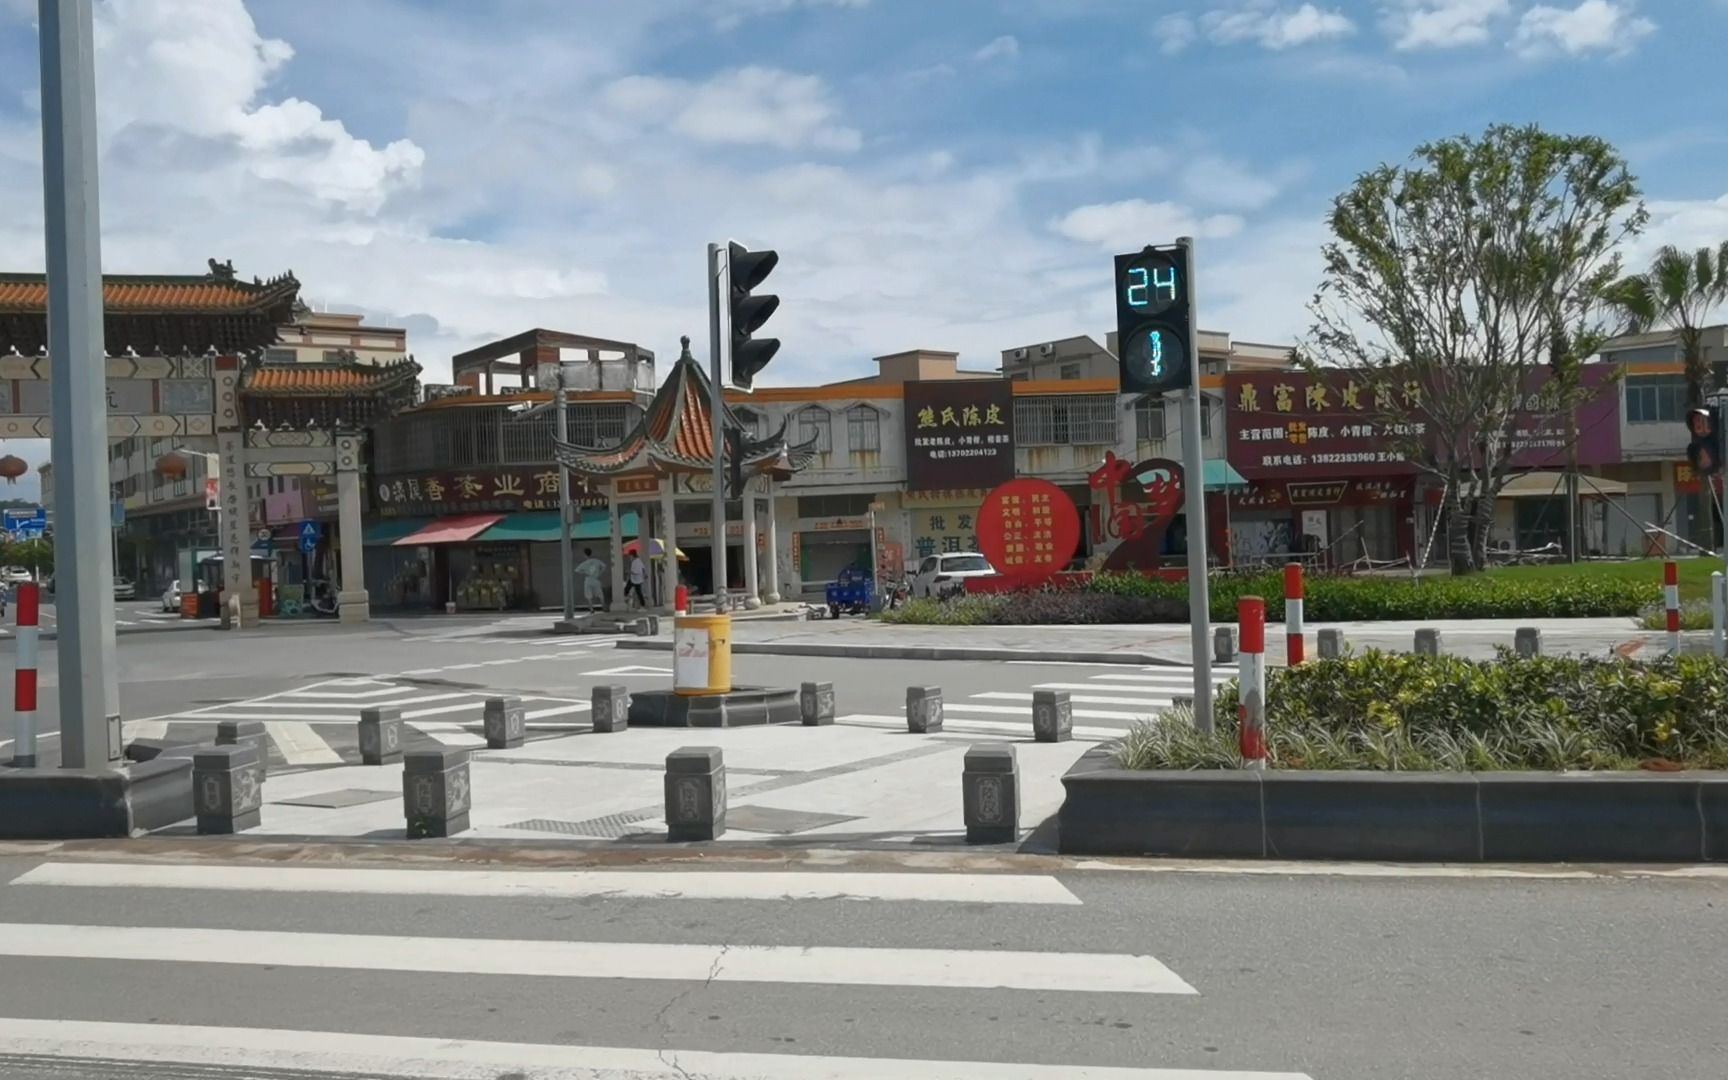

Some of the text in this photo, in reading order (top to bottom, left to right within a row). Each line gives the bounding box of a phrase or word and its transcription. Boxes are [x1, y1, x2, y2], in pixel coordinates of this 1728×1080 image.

[1127, 266, 1176, 306] 24
[917, 403, 1005, 429] 熊氏陈皮
[929, 514, 972, 531] 批发
